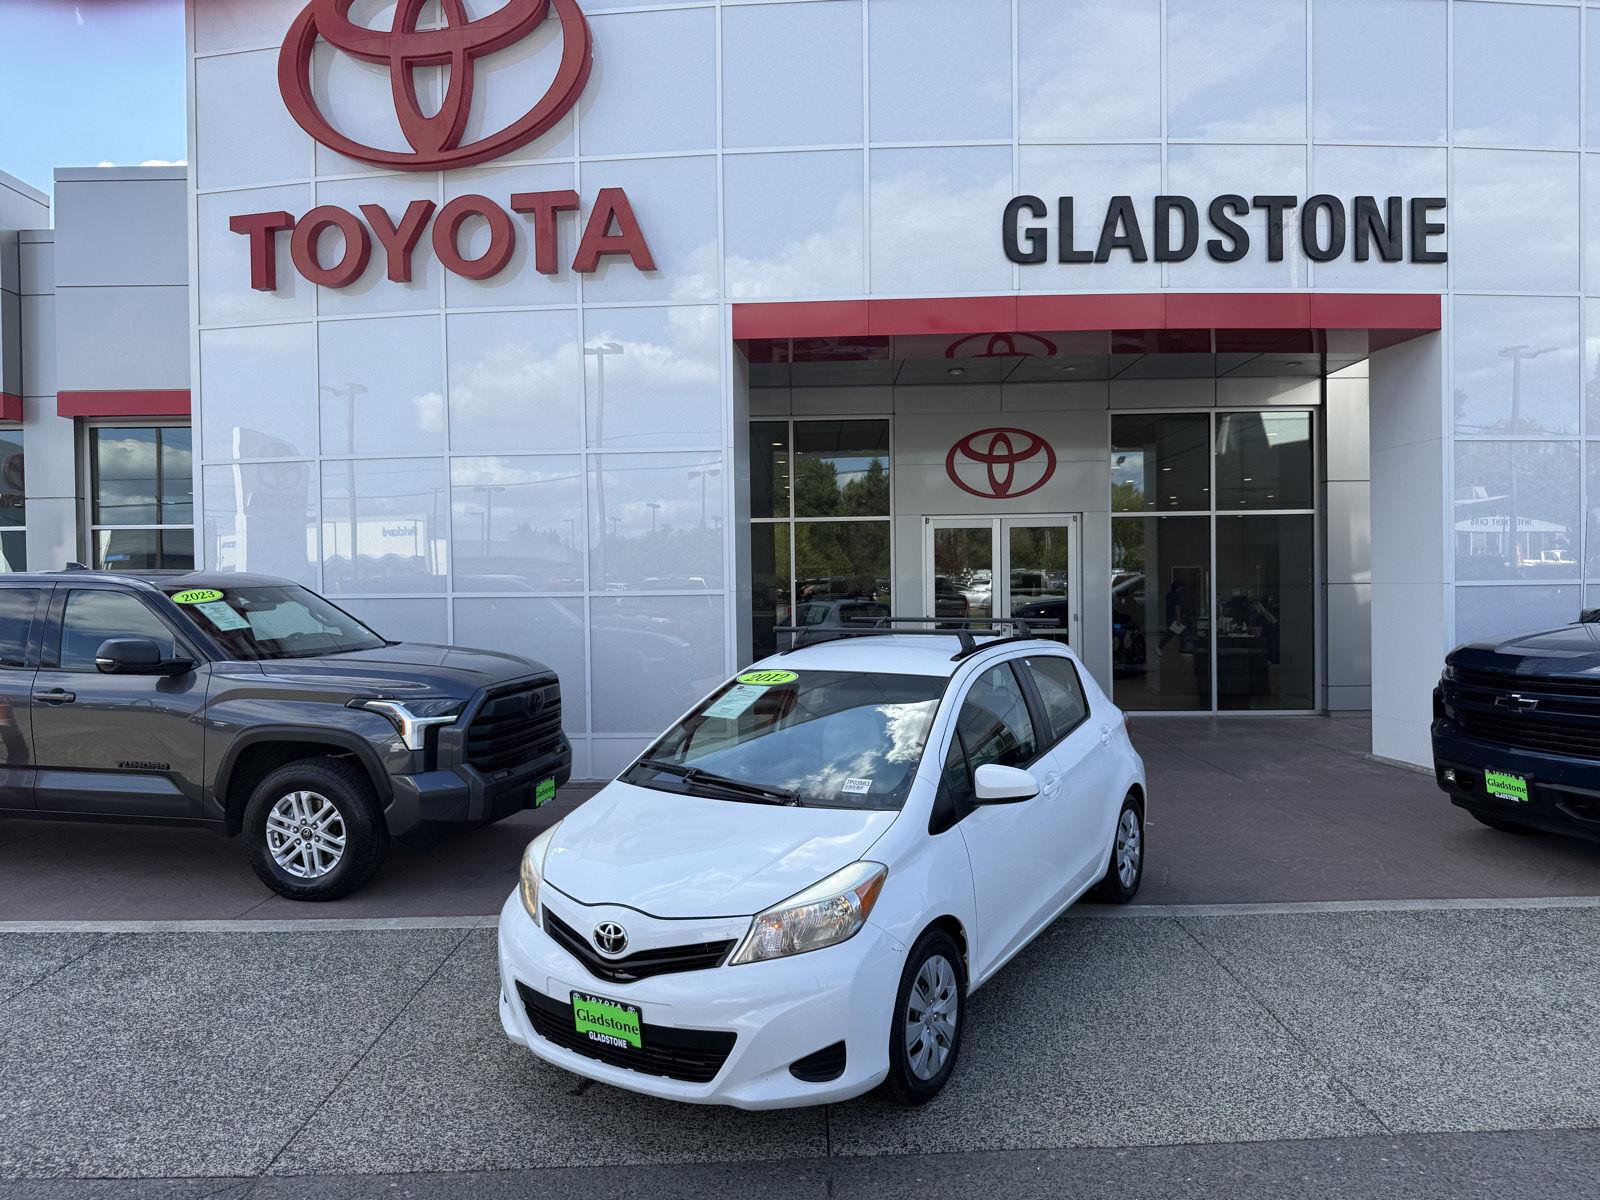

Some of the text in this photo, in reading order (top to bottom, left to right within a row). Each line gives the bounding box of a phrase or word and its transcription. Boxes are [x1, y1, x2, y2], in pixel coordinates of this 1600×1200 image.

[1002, 194, 1448, 265] GLADSTONE
[230, 187, 657, 292] TOYOTA
[181, 590, 215, 602] 2023
[744, 673, 791, 682] 2012
[117, 760, 170, 770] TUNDRA
[1487, 778, 1527, 793] Gladstone
[586, 995, 622, 1009] TOYOTA
[576, 1008, 639, 1035] Gladstone
[588, 1031, 628, 1049] GLADSTONE
